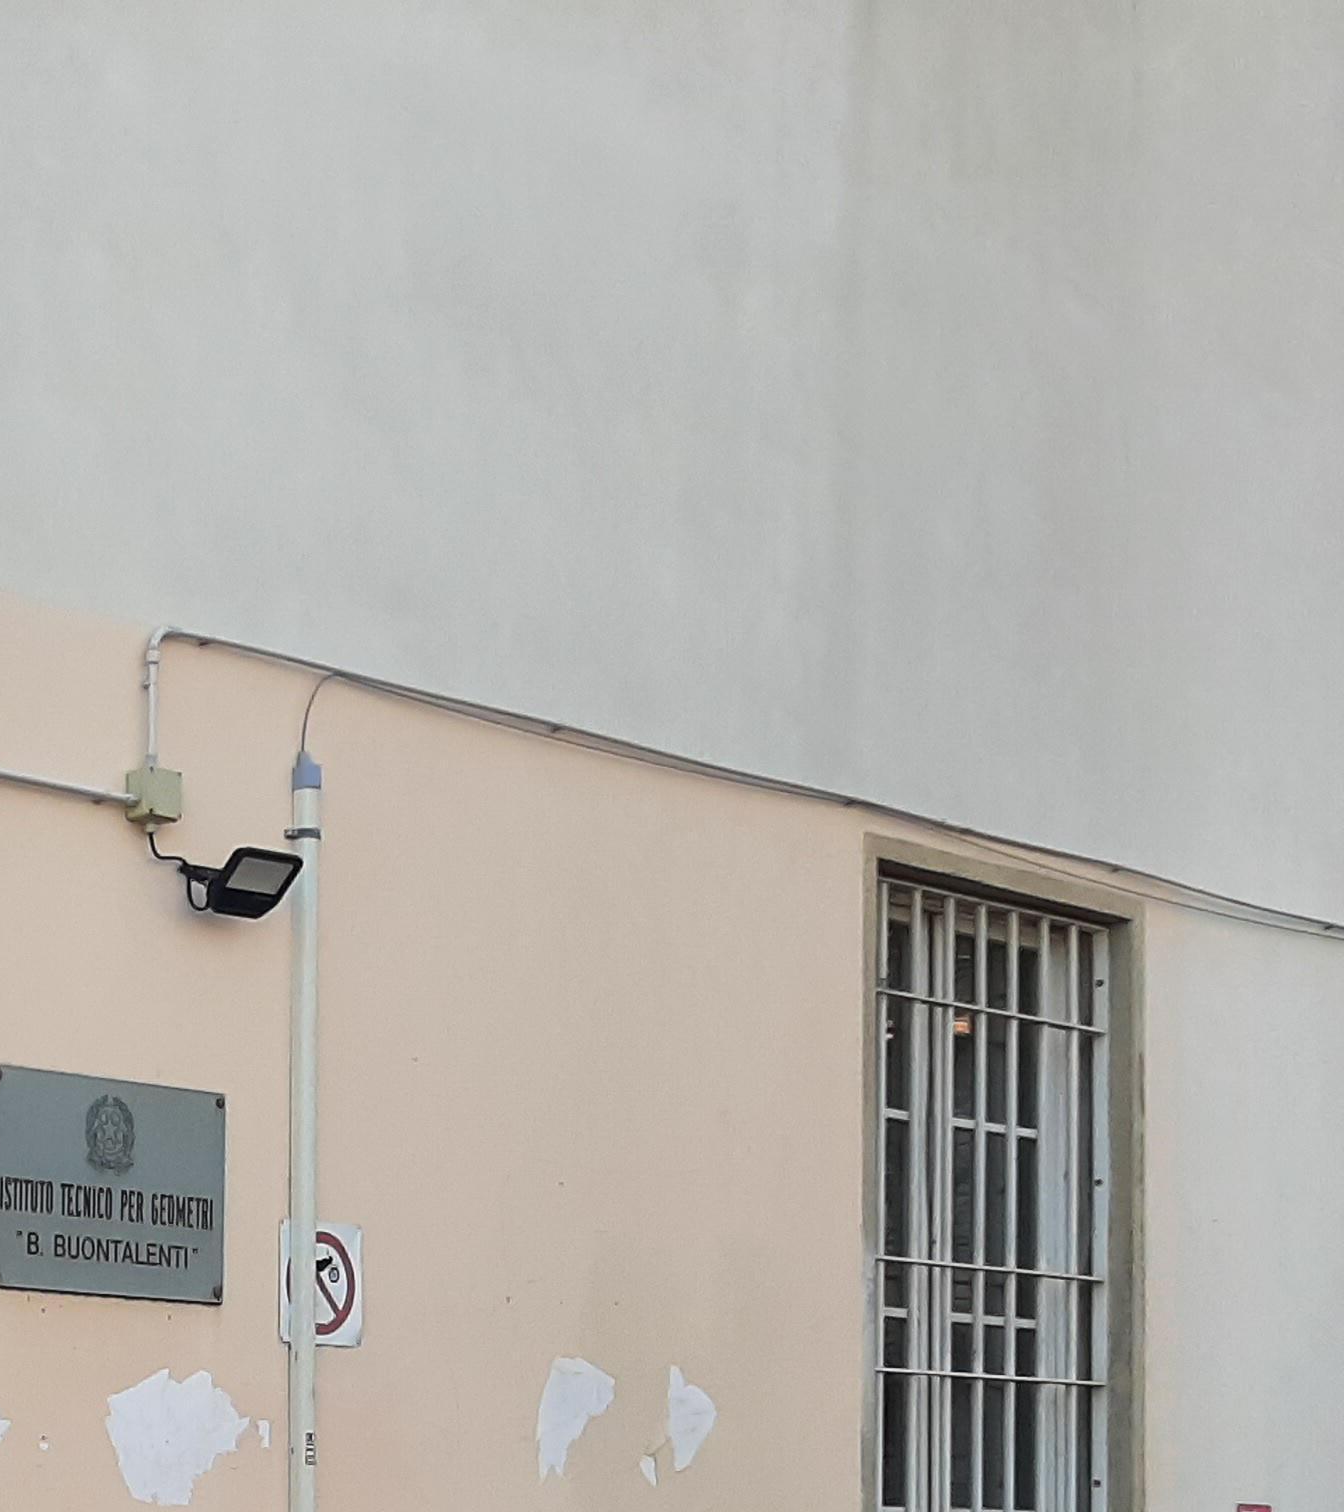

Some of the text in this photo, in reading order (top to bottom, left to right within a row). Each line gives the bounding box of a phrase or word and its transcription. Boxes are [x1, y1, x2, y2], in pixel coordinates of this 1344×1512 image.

[0, 1176, 214, 1232] ISTITUTO TECNICO PER GEOMETRI
